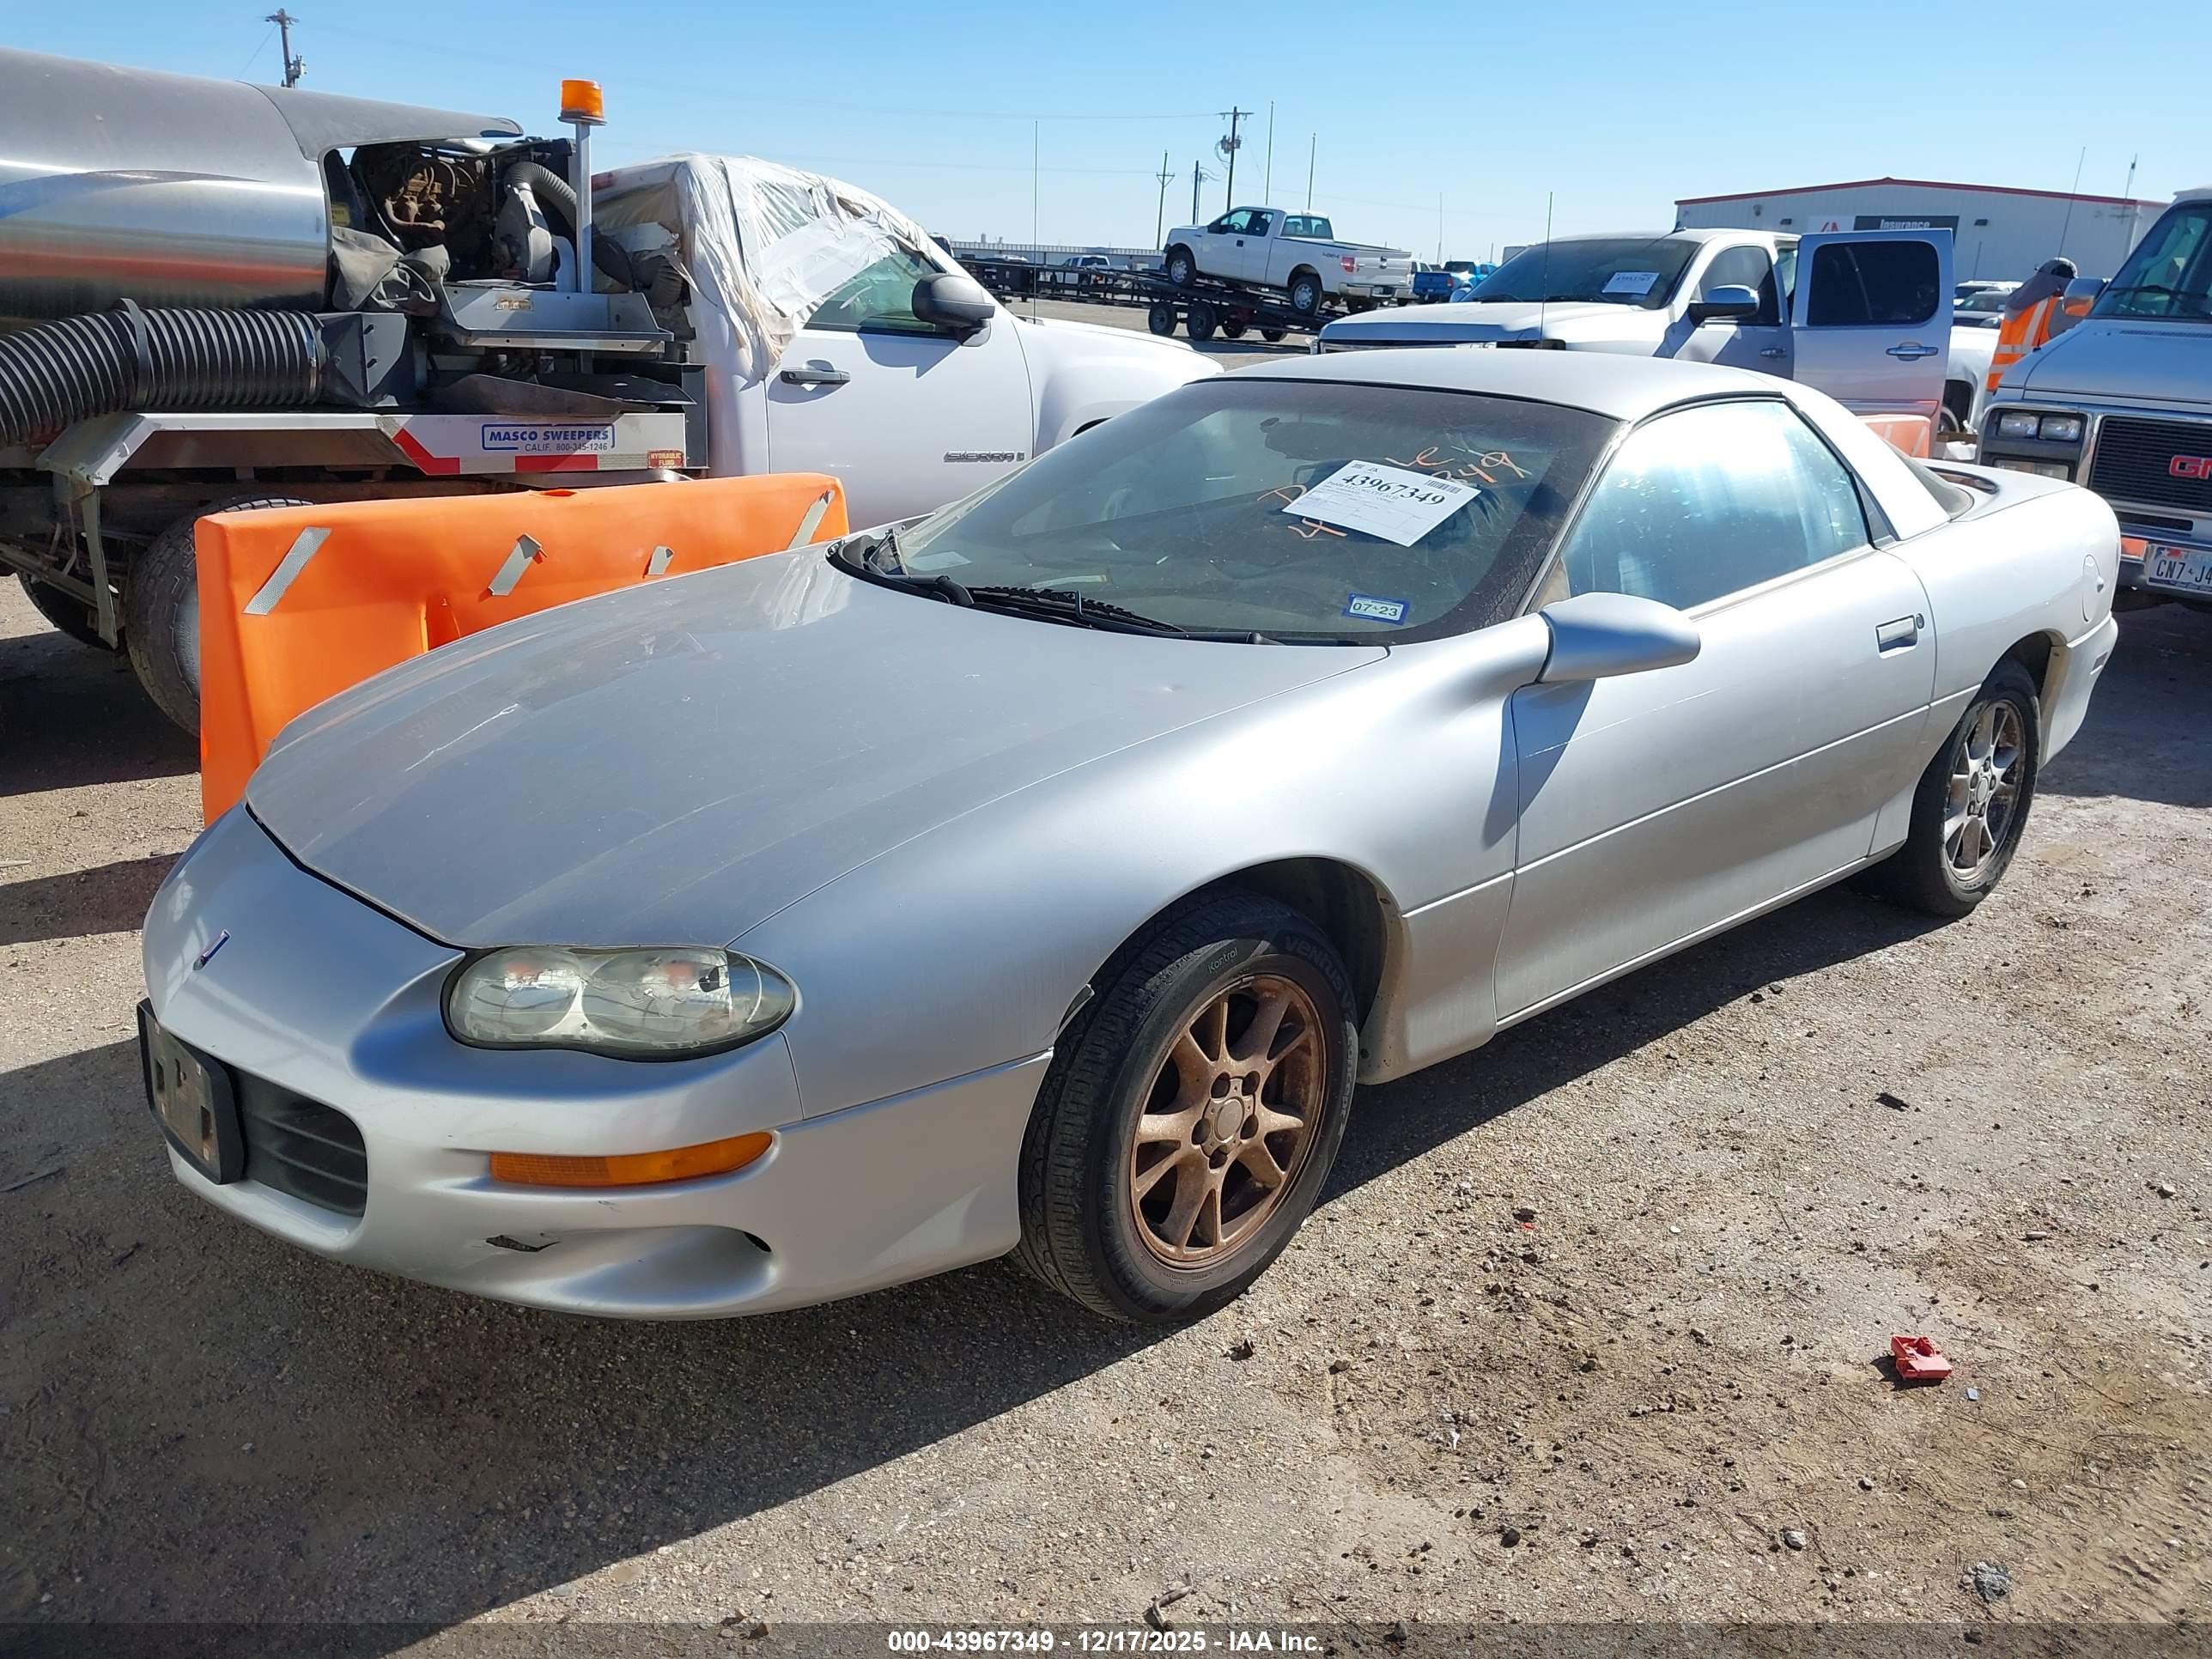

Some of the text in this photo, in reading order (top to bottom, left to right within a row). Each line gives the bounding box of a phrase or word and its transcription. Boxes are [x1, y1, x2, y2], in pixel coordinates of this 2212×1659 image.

[1880, 219, 1930, 230] Insurance
[489, 428, 610, 442] MASCO SWEEPERS
[525, 442, 608, 452] CALIF. 800-345-1246
[943, 451, 1015, 463] SIERRA
[1341, 473, 1446, 506] 43967349
[2155, 559, 2186, 580] CN7
[1207, 947, 1238, 975] Kontrol
